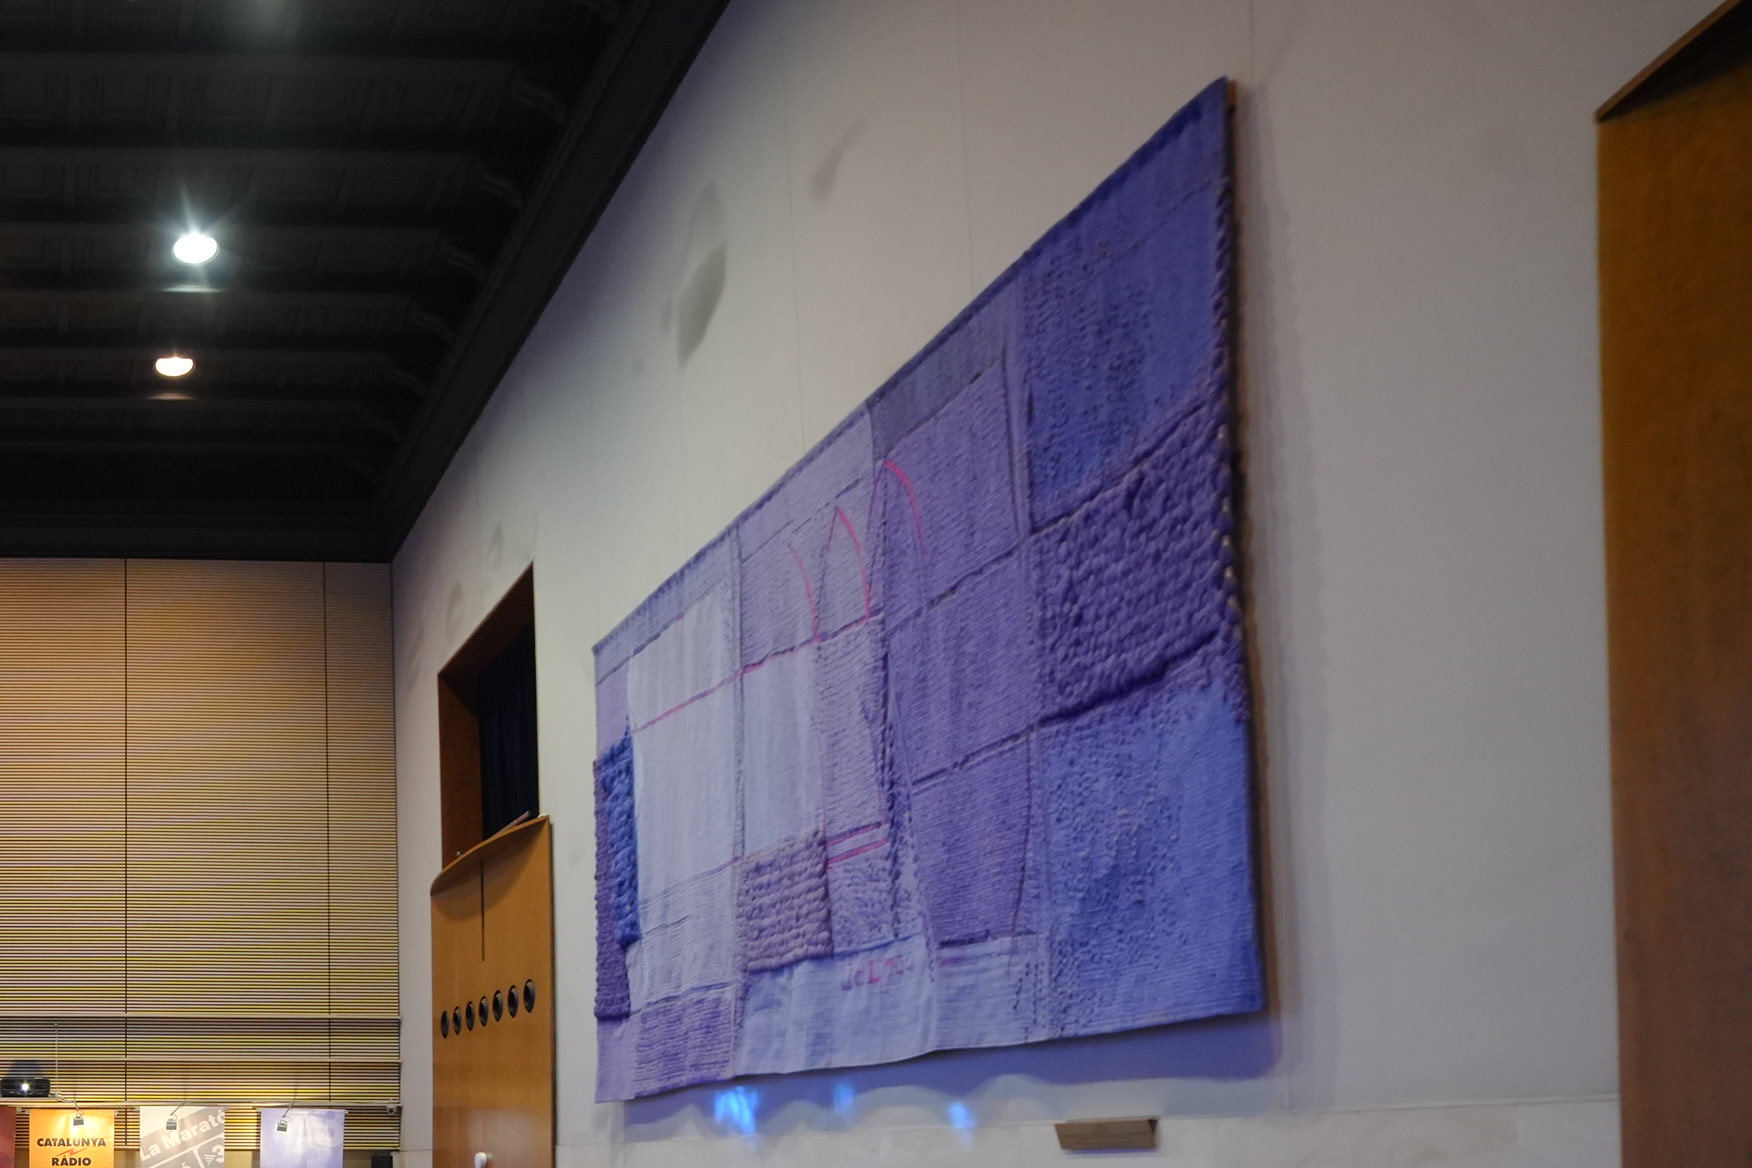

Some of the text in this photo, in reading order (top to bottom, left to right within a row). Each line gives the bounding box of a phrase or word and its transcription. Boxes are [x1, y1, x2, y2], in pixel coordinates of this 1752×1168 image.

[140, 1109, 225, 1162] La Marató
[37, 1138, 106, 1147] CATALUNYA
[52, 1155, 91, 1166] RÀDIO
